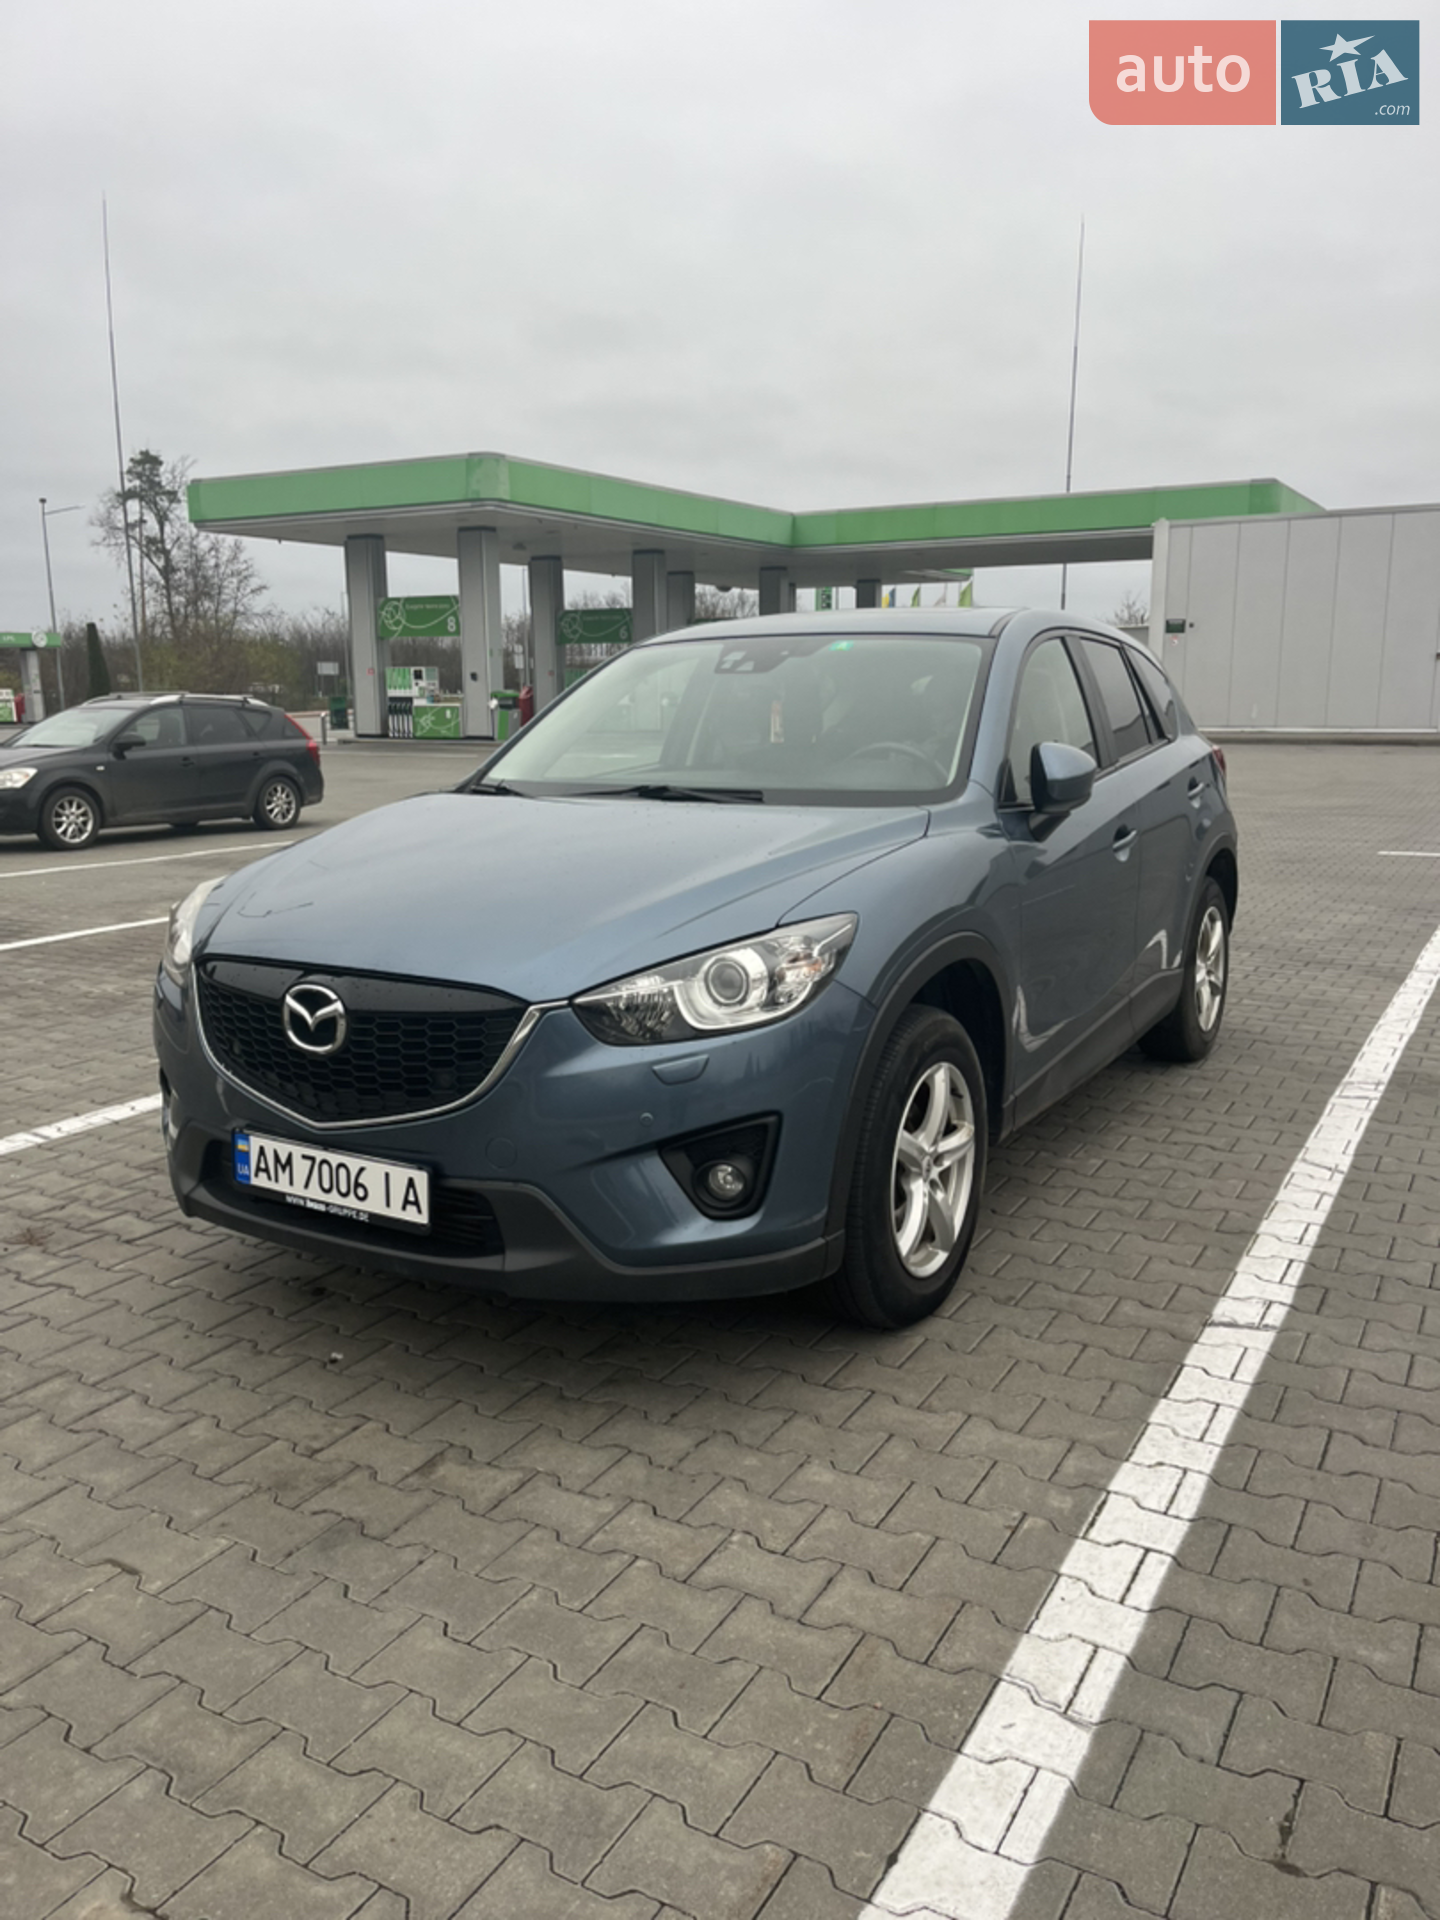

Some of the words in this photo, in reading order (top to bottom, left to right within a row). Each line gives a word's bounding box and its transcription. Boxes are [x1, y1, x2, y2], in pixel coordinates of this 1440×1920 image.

[447, 616, 456, 632] 8
[620, 626, 628, 640] 6
[237, 1162, 250, 1176] UA
[254, 1144, 294, 1187] AM
[301, 1153, 369, 1202] 7006
[384, 1171, 423, 1215] IA
